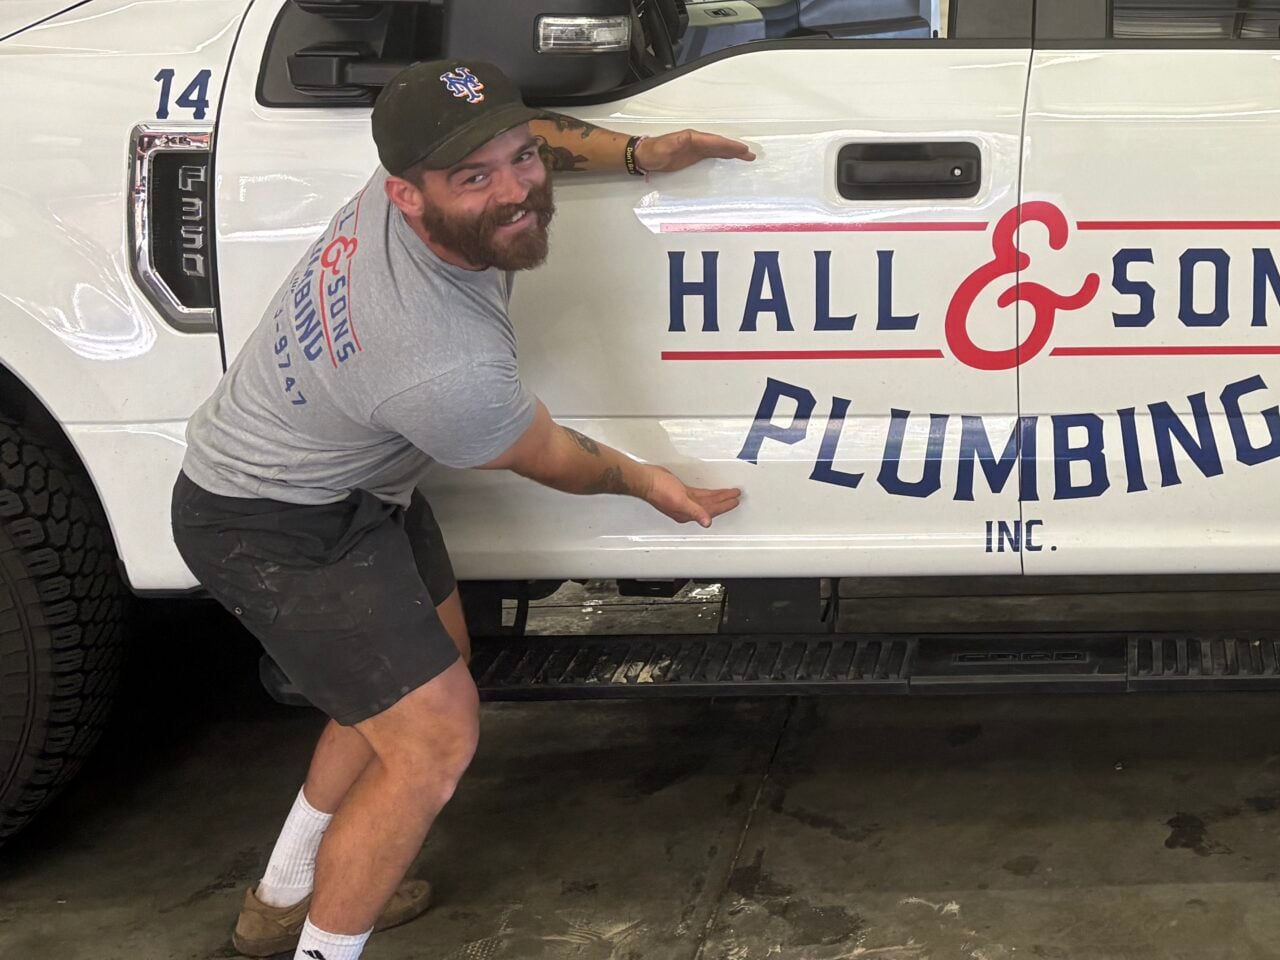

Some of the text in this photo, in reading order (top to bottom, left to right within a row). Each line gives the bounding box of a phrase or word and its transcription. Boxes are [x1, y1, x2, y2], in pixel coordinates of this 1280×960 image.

[154, 68, 211, 120] 14
[327, 273, 358, 363] SONS
[667, 249, 920, 334] HALL
[944, 200, 1100, 371] &
[984, 520, 1060, 554] INC.
